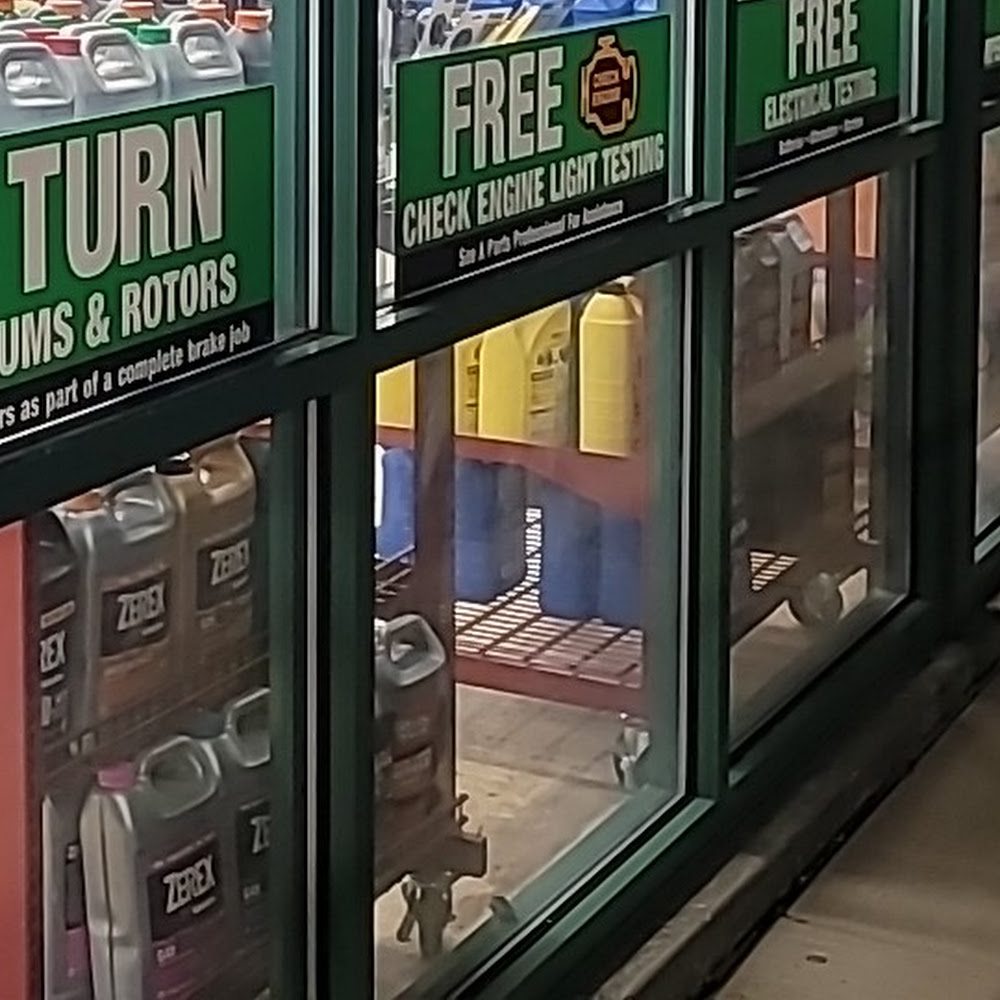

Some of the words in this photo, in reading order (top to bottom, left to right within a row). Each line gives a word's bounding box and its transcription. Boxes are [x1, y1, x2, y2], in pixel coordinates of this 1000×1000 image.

[442, 46, 564, 179] FREE
[8, 110, 223, 293] TURN
[403, 187, 471, 249] CHECK
[477, 166, 545, 226] ENGINE
[550, 151, 598, 203] LIGHT
[602, 132, 664, 187] TESTING
[85, 292, 110, 348] &
[121, 254, 237, 339] ROTORS
[20, 396, 40, 422] as
[45, 377, 79, 418] part
[83, 370, 99, 399] of
[103, 373, 112, 392] a
[117, 345, 183, 382] complete
[187, 331, 226, 364] brake
[229, 320, 251, 353] job
[117, 582, 166, 631] ZEREX
[163, 854, 216, 914] ZEREX
